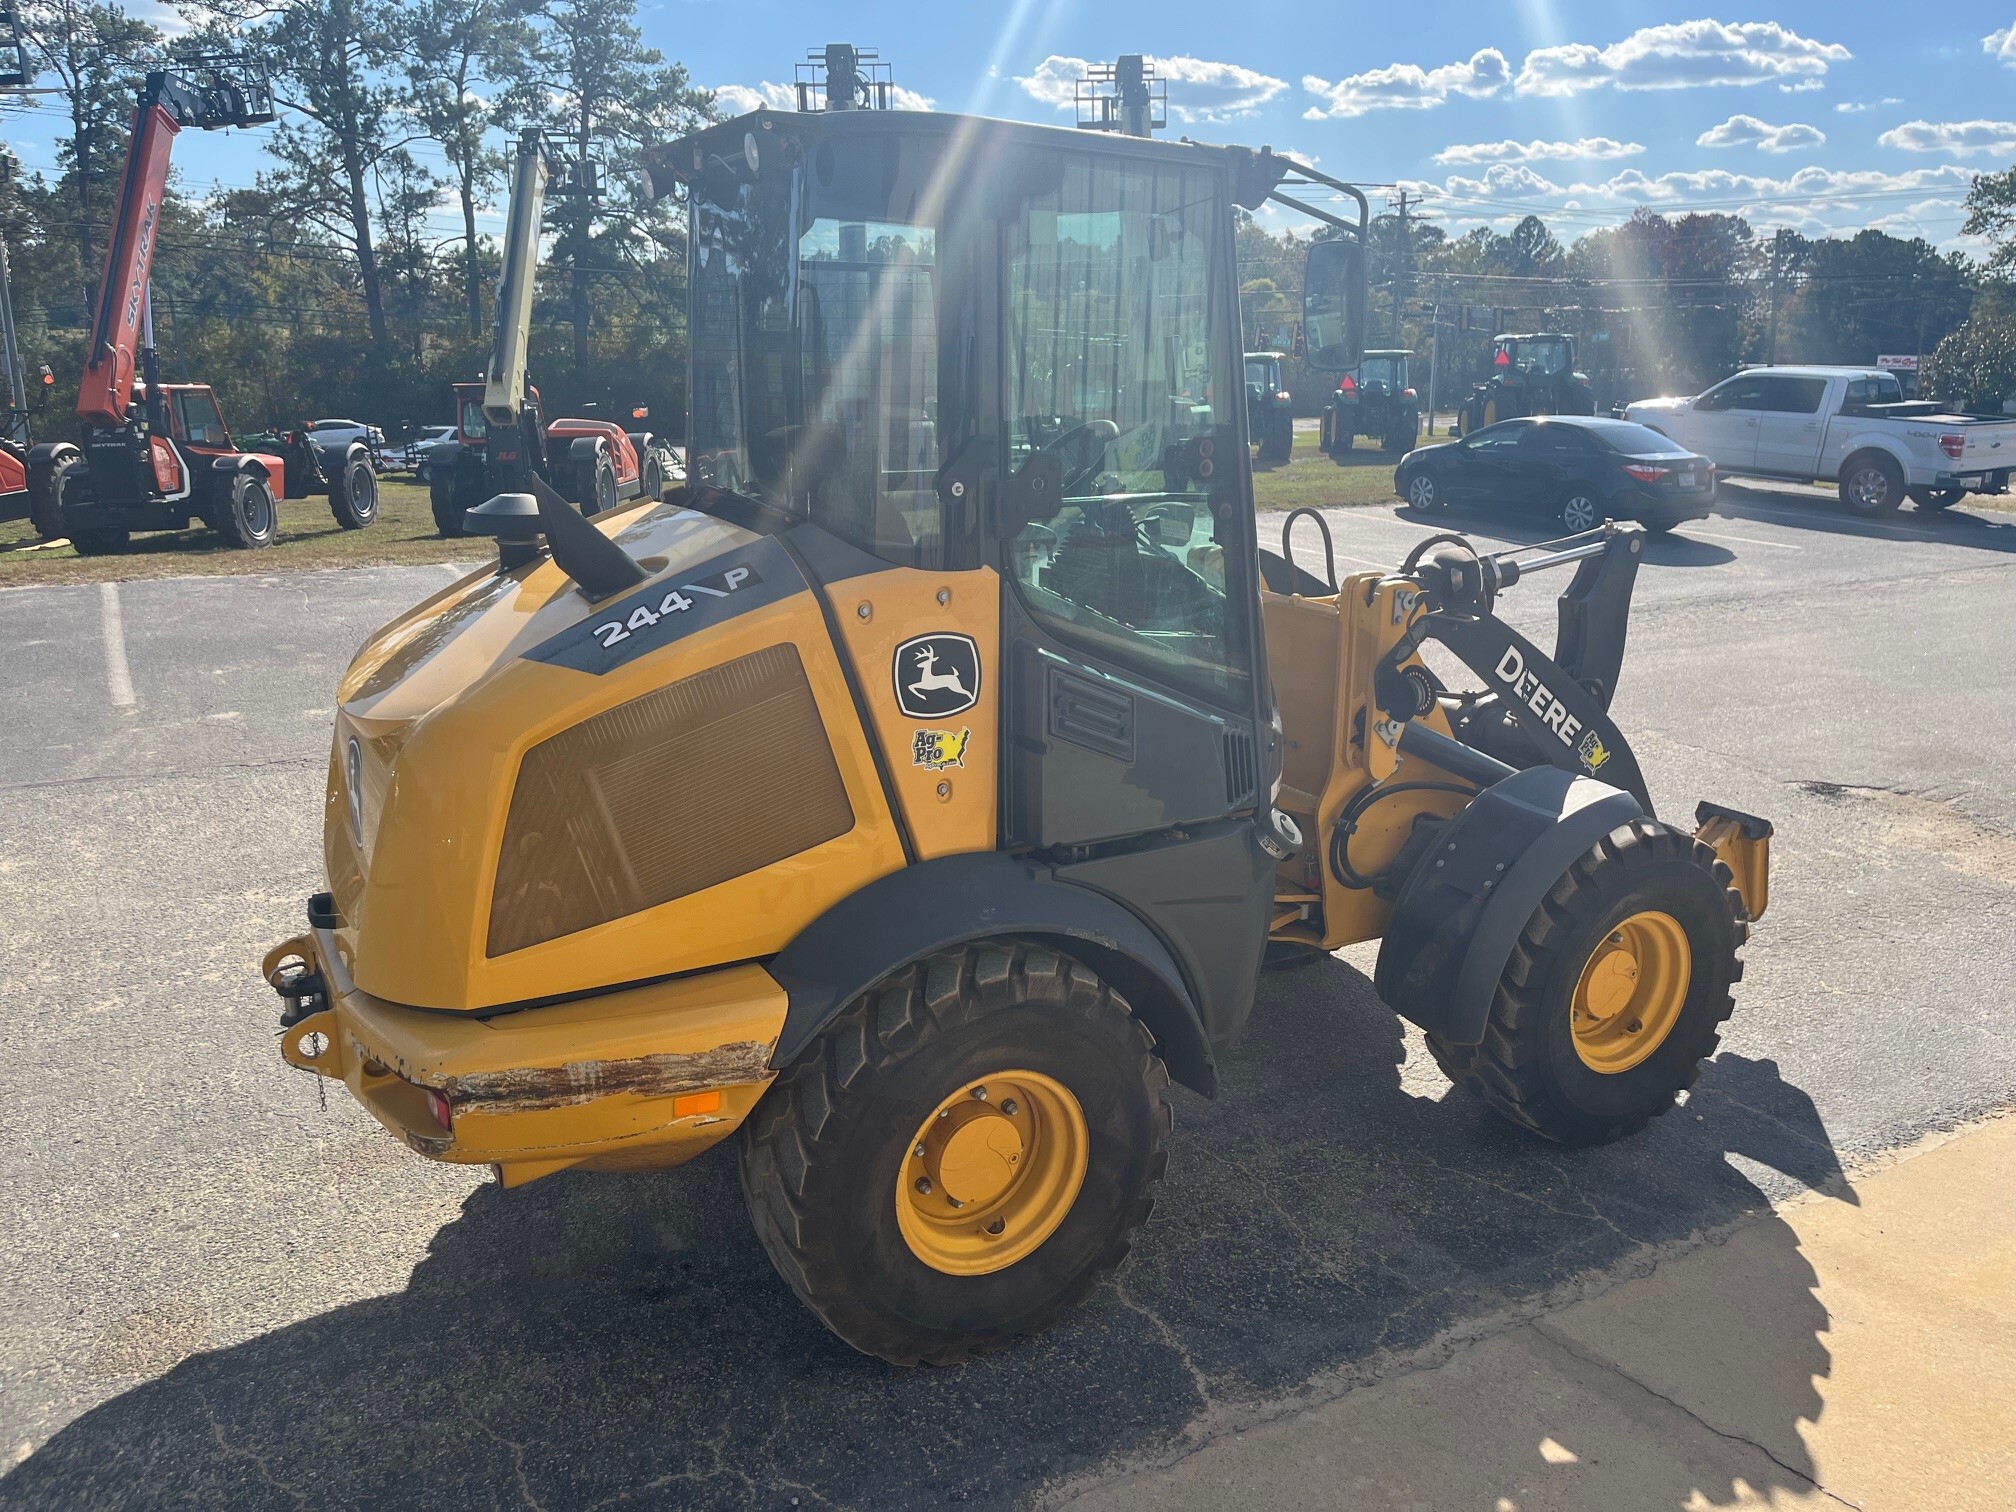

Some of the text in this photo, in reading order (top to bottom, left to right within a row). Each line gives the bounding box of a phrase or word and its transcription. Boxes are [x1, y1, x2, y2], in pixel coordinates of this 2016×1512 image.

[175, 80, 201, 97] 8042
[127, 192, 157, 332] SKYTRAK
[496, 451, 518, 461] JLG
[723, 567, 750, 591] P
[1494, 644, 1583, 747] DEERE
[914, 731, 943, 749] Ag-
[914, 746, 943, 763] Pro
